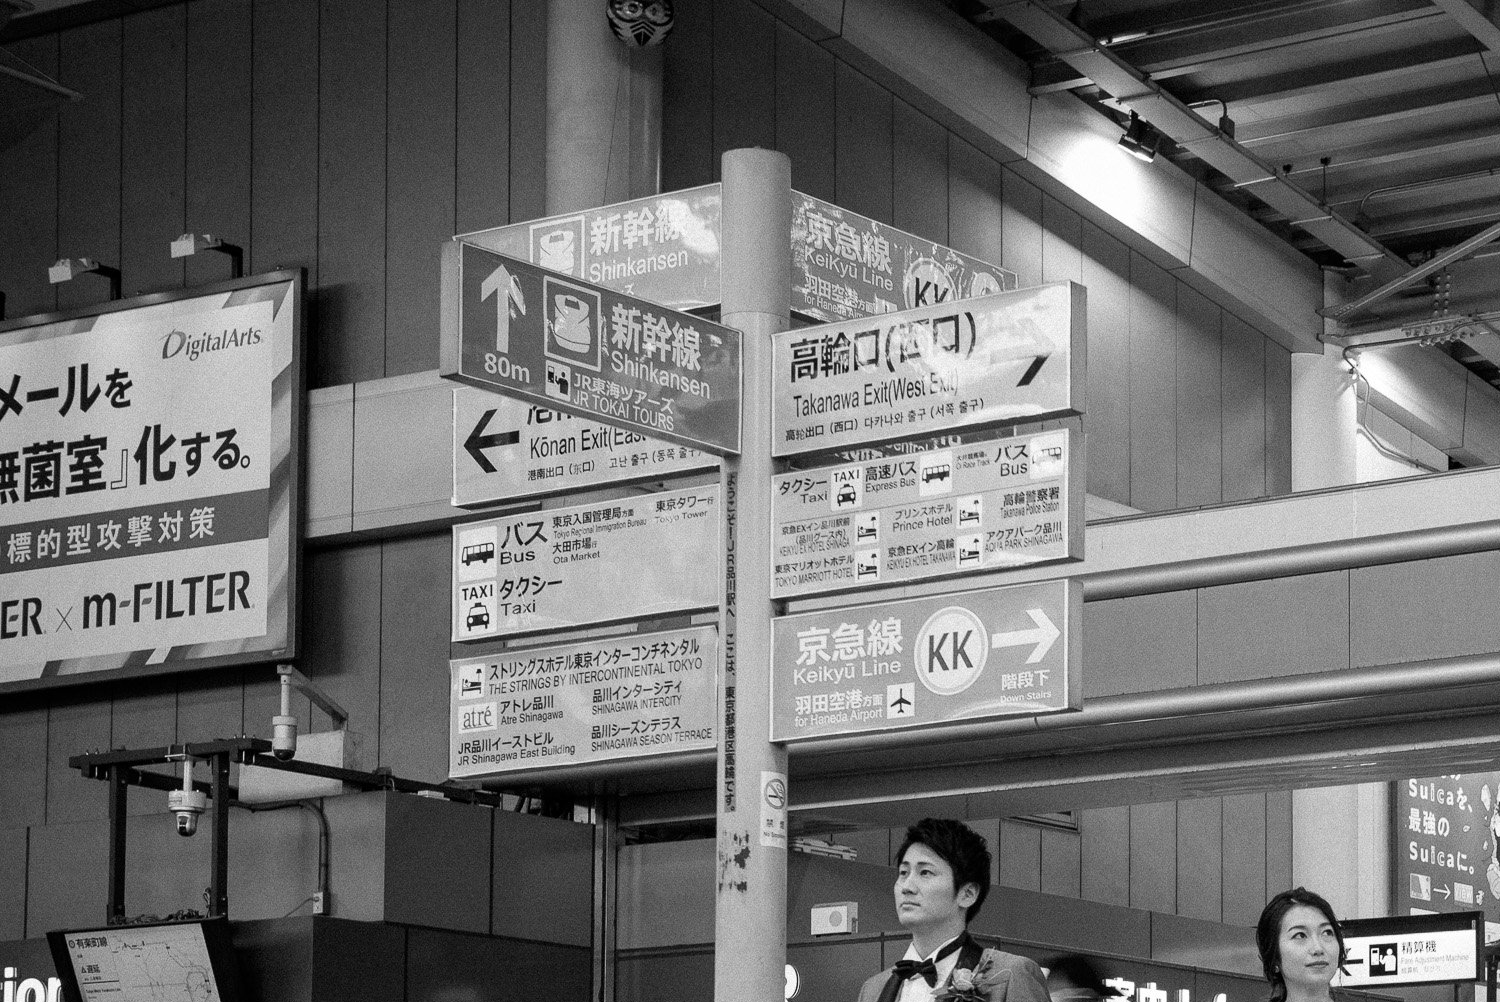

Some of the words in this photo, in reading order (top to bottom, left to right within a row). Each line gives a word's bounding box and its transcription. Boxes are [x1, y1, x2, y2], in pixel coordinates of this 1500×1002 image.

[588, 250, 689, 284] Shinkansen
[862, 266, 894, 292] Line
[161, 325, 262, 362] DigitalArts
[611, 302, 702, 372] 新幹線
[484, 352, 530, 384] 80m
[610, 350, 711, 399] Shinkansen
[573, 371, 675, 415] JR東海ツアーズ
[793, 389, 860, 418] Takanawa
[573, 389, 590, 409] JR
[593, 398, 630, 421] TOKAI
[632, 405, 675, 431] TOURS
[530, 434, 577, 460] Kōnan
[994, 444, 1029, 463] バス
[833, 469, 860, 483] TAXI
[864, 460, 917, 482] 高速バス
[1000, 462, 1028, 477] Bus
[779, 477, 828, 496] タクシー
[865, 480, 898, 493] Express
[899, 477, 916, 487] Bus
[800, 491, 828, 504] Taxi
[682, 510, 708, 521] Tower
[892, 518, 925, 532] Prince
[926, 513, 953, 528] Hotel
[894, 503, 952, 521] プリンスホテル
[6, 505, 216, 564] 標的型攻撃対策
[500, 521, 549, 549] バス
[986, 521, 1062, 543] アクアパーク品川
[500, 550, 536, 566] Bus
[553, 555, 569, 565] Ota
[570, 550, 601, 563] Market
[82, 569, 252, 630] m-FILTER
[461, 583, 494, 601] TAXI
[499, 575, 563, 600] タクシー
[500, 599, 536, 617] Taxi
[795, 616, 903, 667] 京急線
[928, 629, 974, 674] KK
[489, 638, 700, 681] ストリングスホテル東京インターコンチネンタル
[488, 681, 508, 696] THE
[509, 676, 552, 693] STRINGS
[553, 674, 567, 687] BY
[569, 662, 666, 686] INTERCONTINENTAL
[667, 657, 703, 673] TOKYO
[793, 662, 856, 686] Keikyū
[861, 658, 902, 678] Line
[1001, 669, 1051, 691] 階段下
[592, 680, 682, 704] 品川インターシティ
[794, 688, 884, 715] 羽田空港方面
[1000, 692, 1025, 705] Down
[1026, 688, 1052, 701] Stairs
[500, 694, 554, 715] アトレ品川
[591, 699, 639, 716] SHINAGAWA
[640, 694, 683, 710] INTERCITY
[500, 715, 518, 726] Atre
[519, 710, 564, 724] Shinagawa
[591, 716, 682, 740] 品川シーズンテラス
[794, 714, 808, 728] for
[810, 710, 849, 727] Haneda
[849, 706, 884, 723] Airport
[457, 731, 554, 755] JR品川イーストビル
[591, 737, 639, 752] SHINAGAWA
[639, 732, 673, 747] SEASON
[674, 727, 713, 742] TERRACE
[457, 755, 470, 767] JR
[471, 752, 518, 765] Shinagawa
[519, 748, 540, 759] East
[541, 744, 576, 757] Building
[1408, 778, 1473, 813] Suicaを、
[1408, 807, 1450, 838] 最強の
[1408, 841, 1475, 875] Suicaに。
